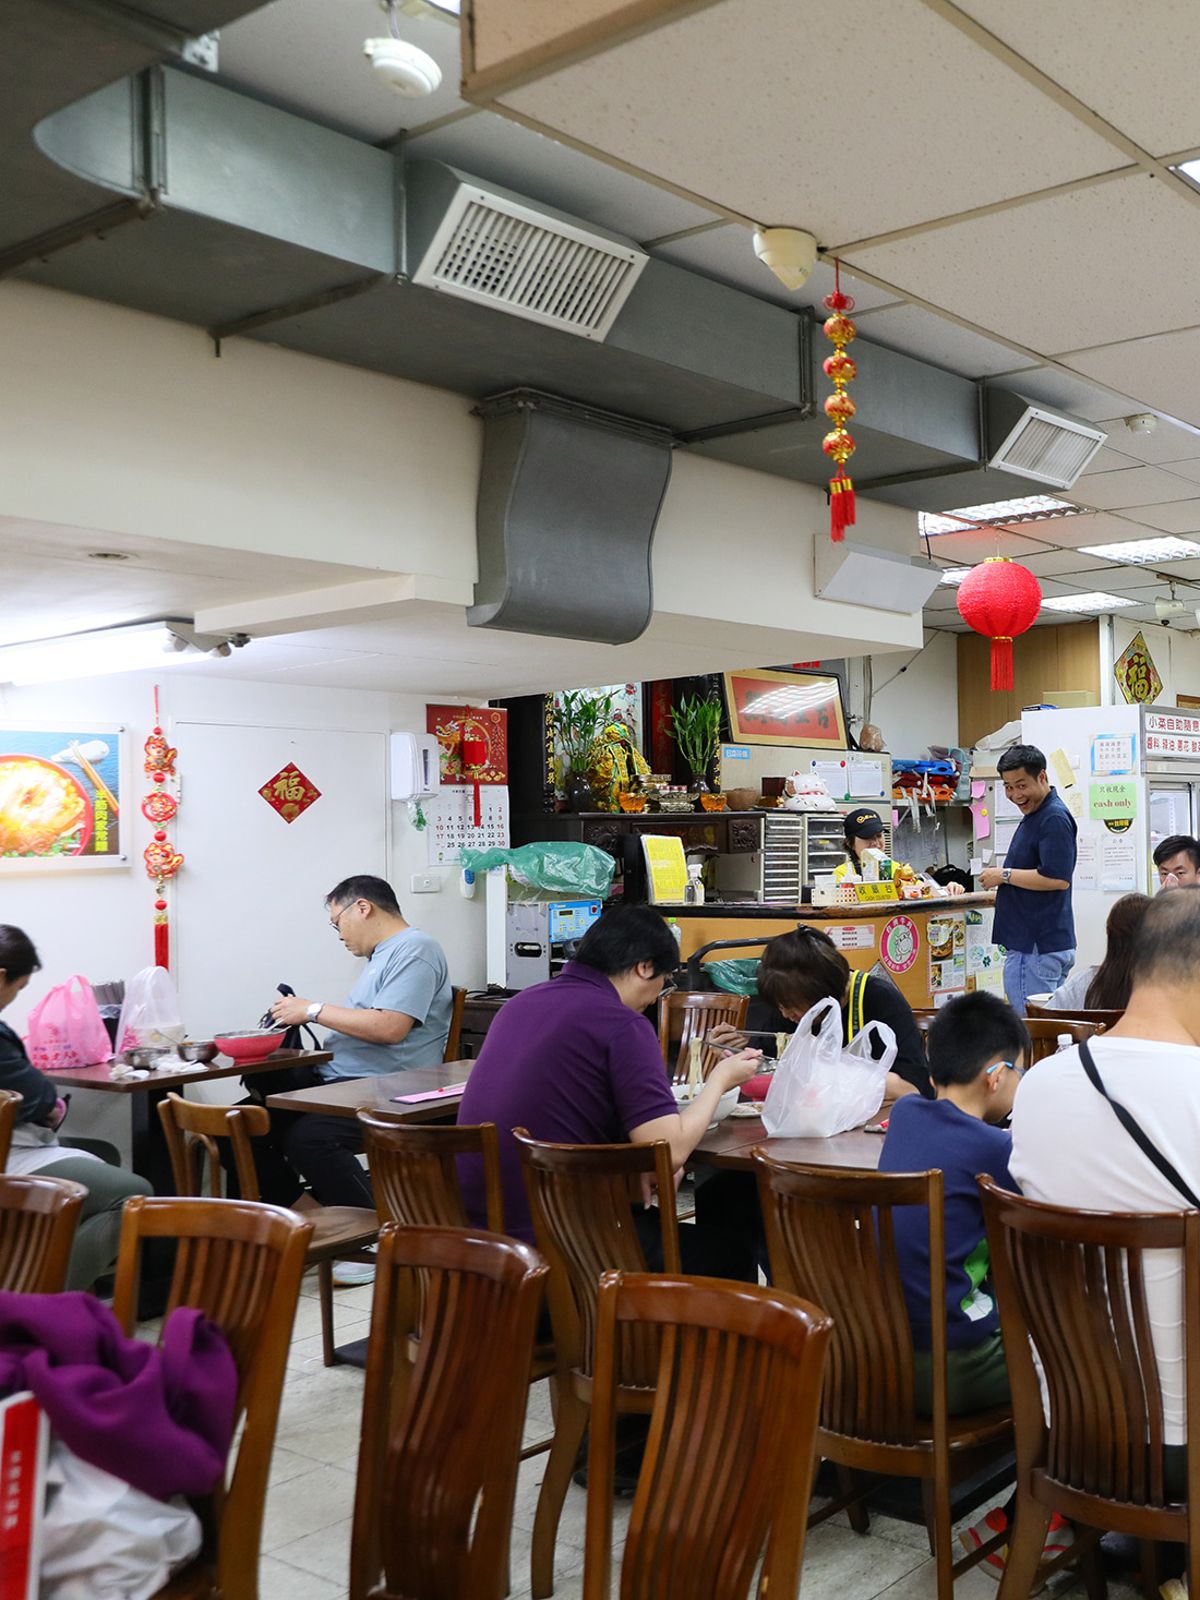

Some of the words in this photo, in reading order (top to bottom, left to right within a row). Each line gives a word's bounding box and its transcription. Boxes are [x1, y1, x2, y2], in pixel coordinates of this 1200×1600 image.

[1128, 655, 1149, 700] 福
[273, 771, 305, 800] 福
[1094, 800, 1113, 808] cash
[1114, 798, 1131, 809] only
